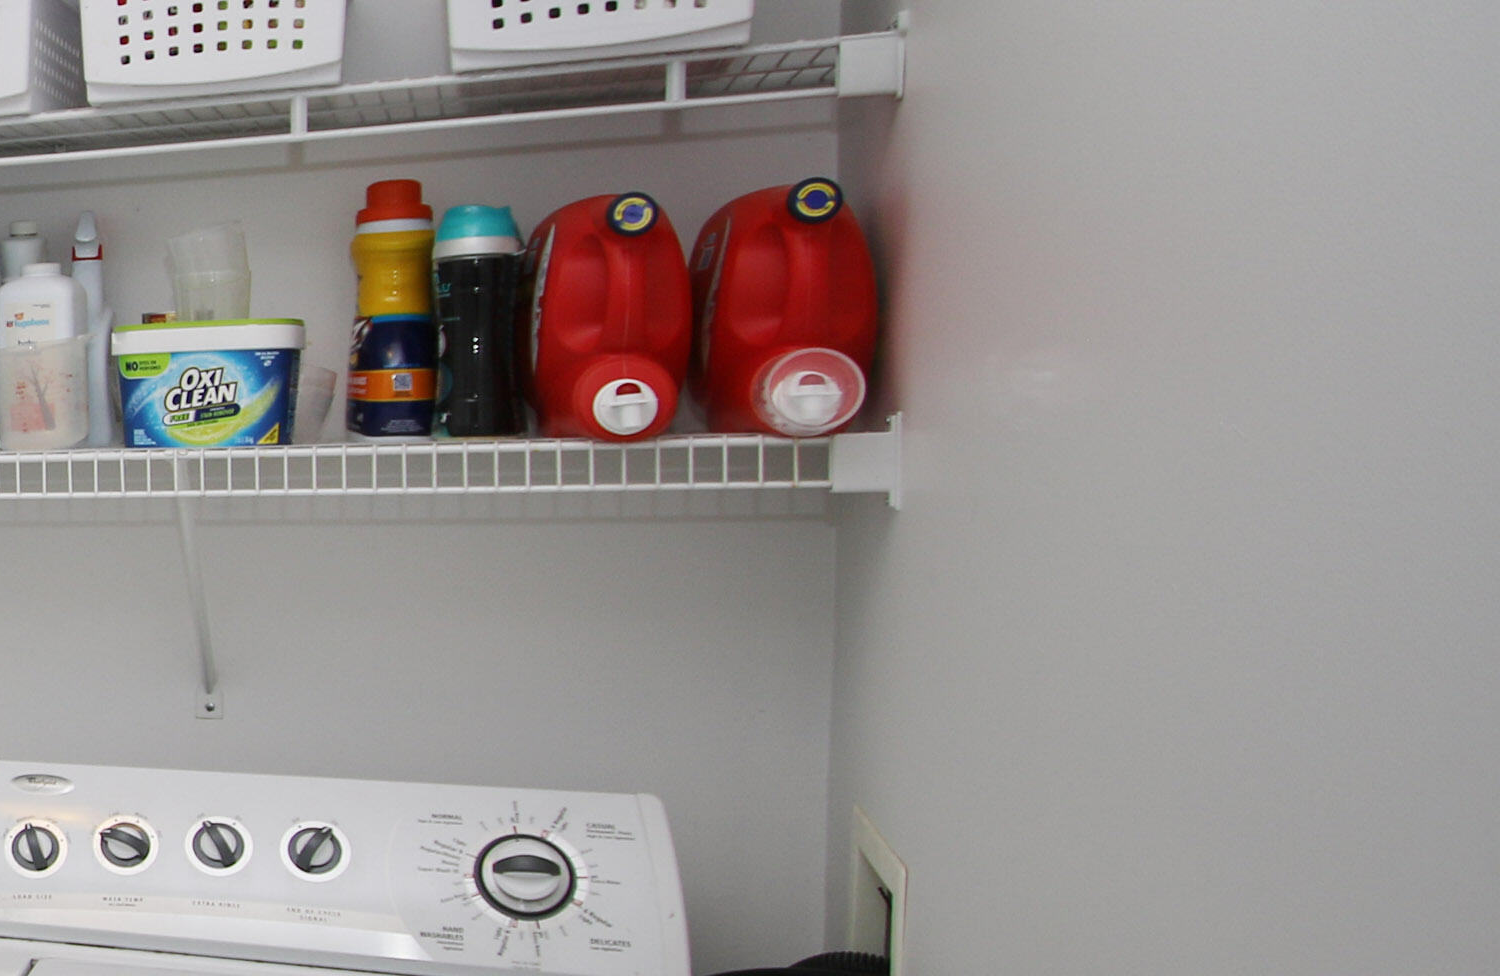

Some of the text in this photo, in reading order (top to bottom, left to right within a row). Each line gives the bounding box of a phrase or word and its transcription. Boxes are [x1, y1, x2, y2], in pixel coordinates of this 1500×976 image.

[126, 361, 139, 372] NO
[181, 367, 224, 391] OXI
[165, 382, 237, 412] CLEAN
[589, 937, 632, 948] DELICATES
